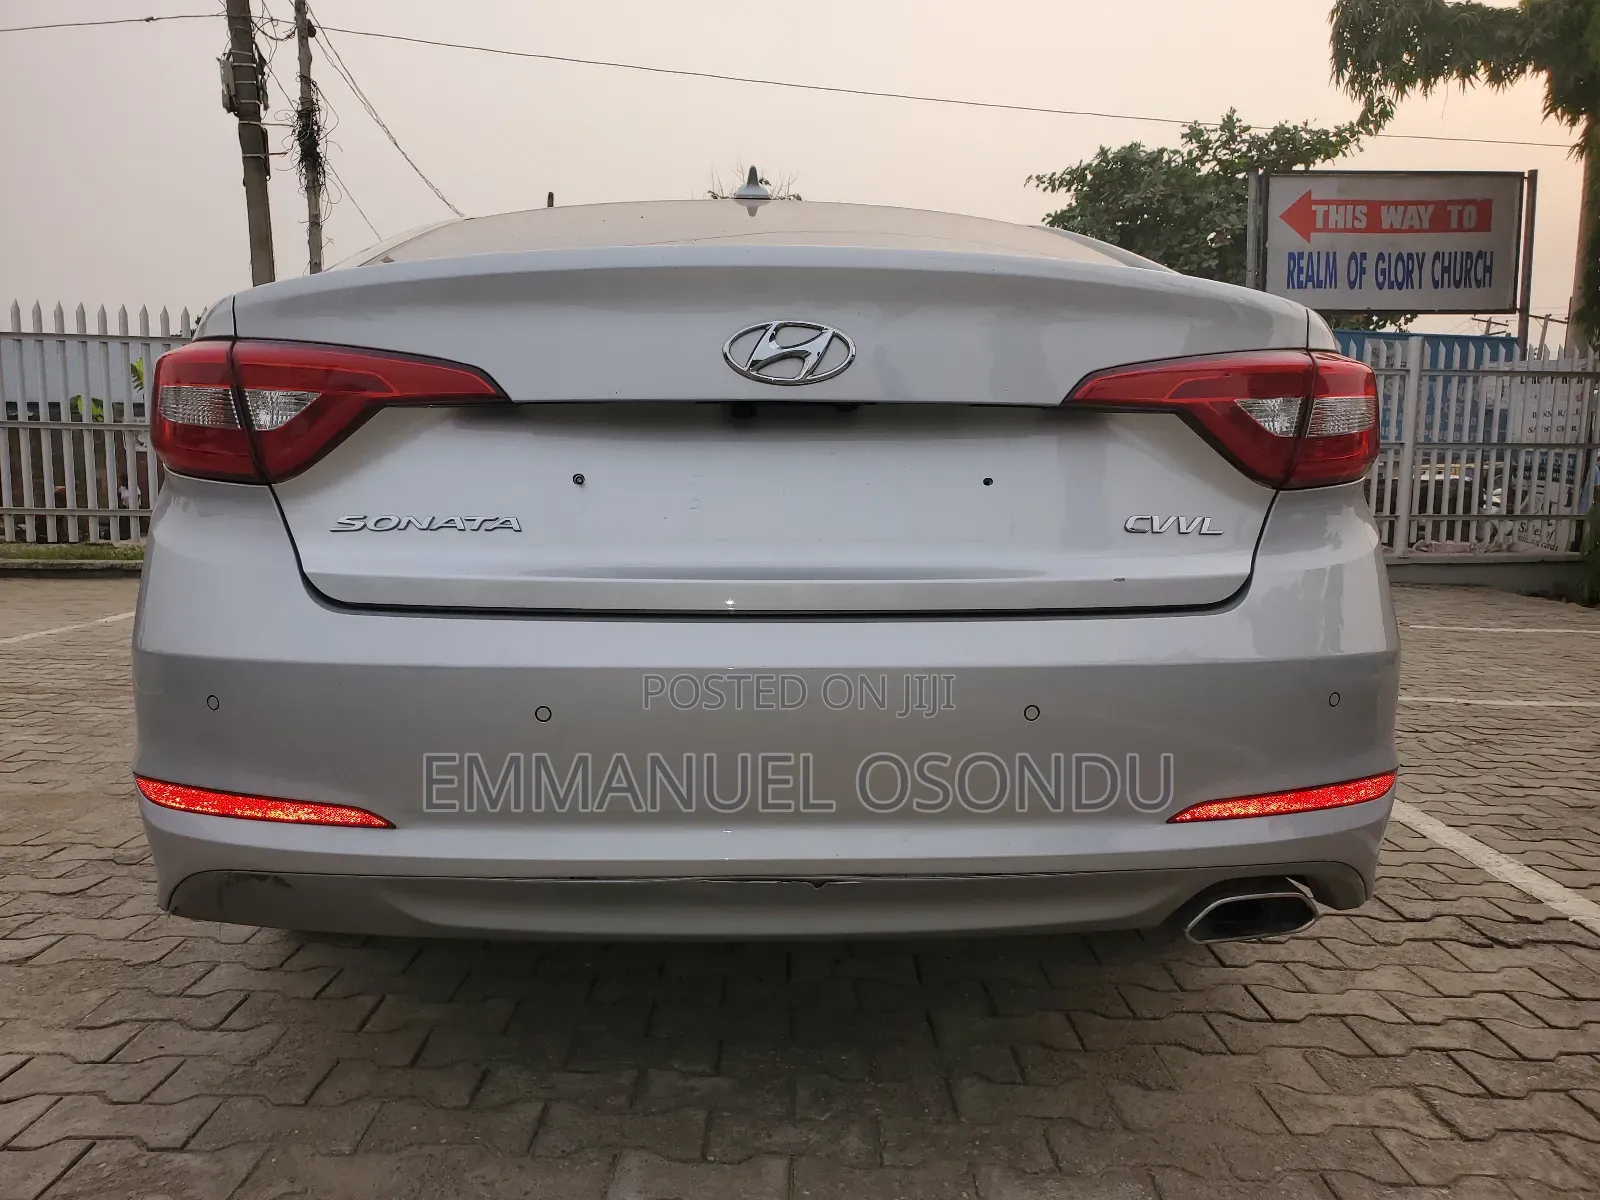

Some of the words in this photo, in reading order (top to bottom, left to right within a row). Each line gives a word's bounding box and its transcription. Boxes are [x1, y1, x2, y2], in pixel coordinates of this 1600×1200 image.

[1311, 204, 1368, 229] THIS
[1380, 204, 1435, 230] WAY
[1447, 204, 1478, 230] TO
[1286, 251, 1338, 290] REALM
[1346, 251, 1368, 290] OF
[1374, 251, 1427, 291] GLORY
[1431, 250, 1494, 289] CHURCH
[329, 514, 523, 533] SONATA
[1123, 514, 1225, 536] CVVL
